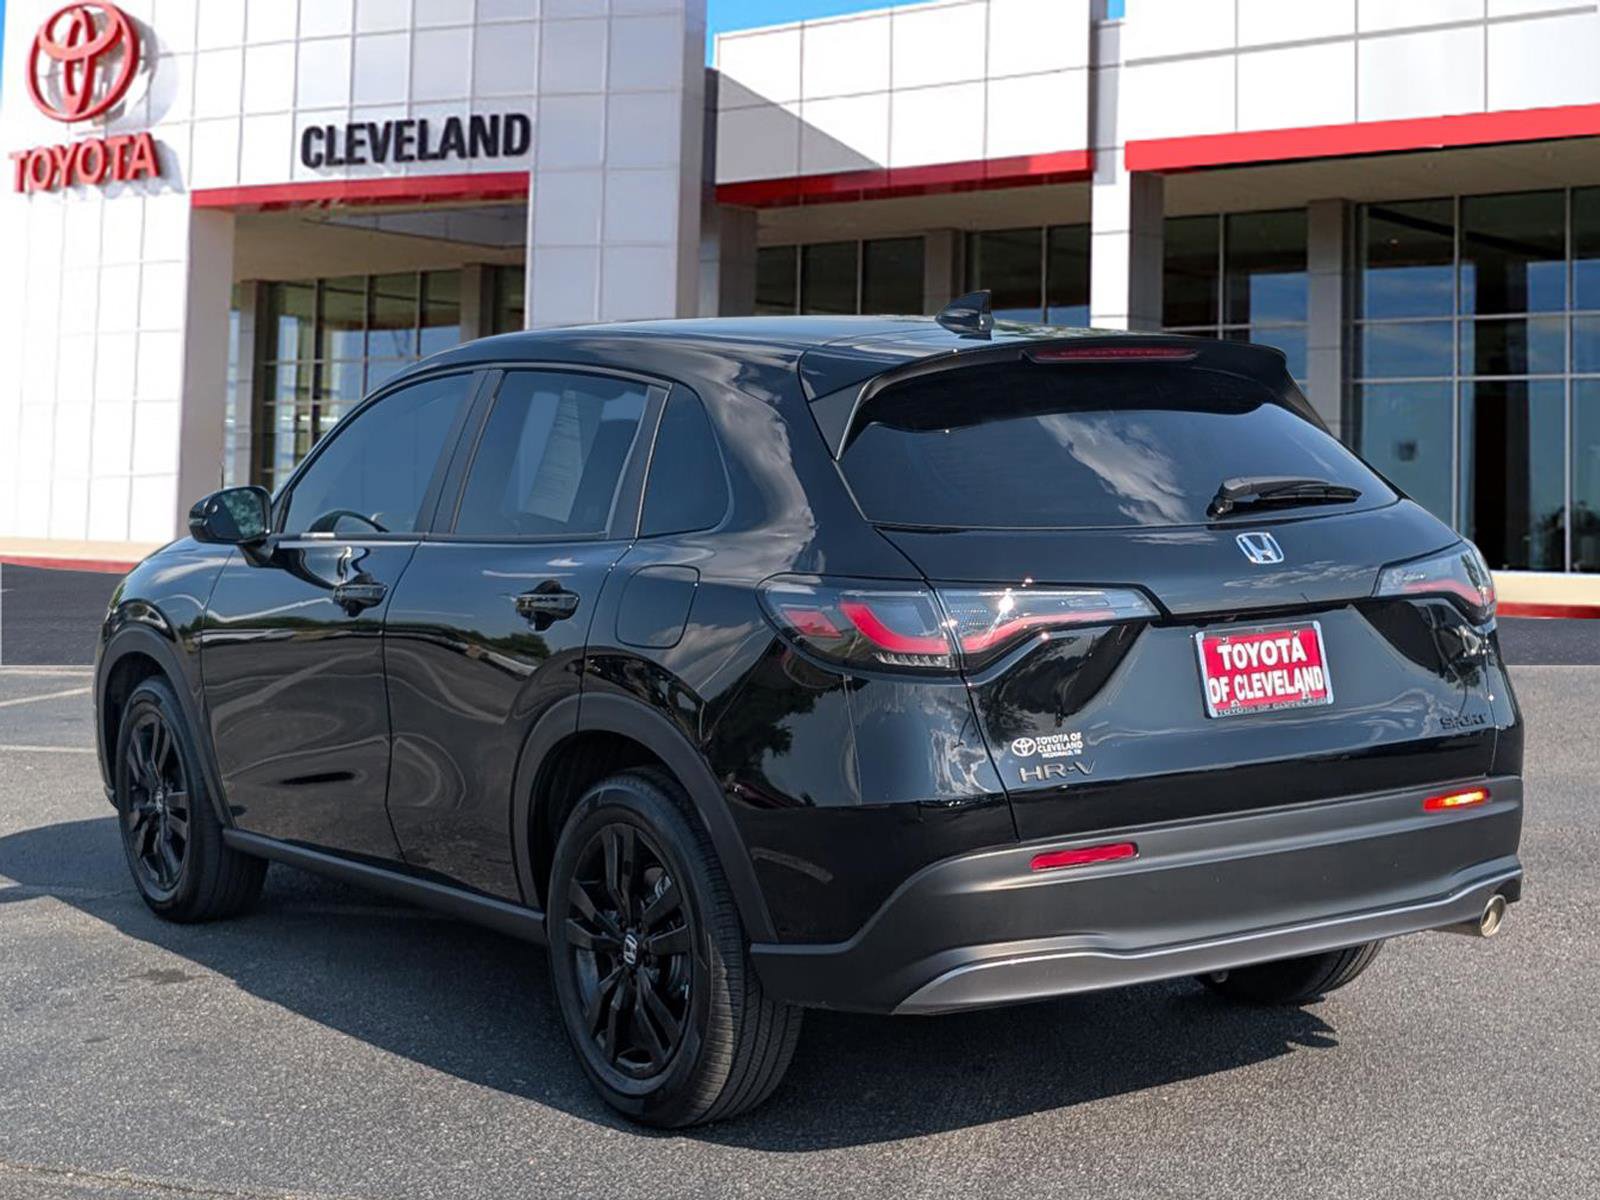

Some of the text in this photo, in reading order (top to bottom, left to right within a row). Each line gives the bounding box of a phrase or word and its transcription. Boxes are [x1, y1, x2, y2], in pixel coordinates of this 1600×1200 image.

[301, 112, 531, 168] CLEVELAND
[9, 132, 162, 193] TOYOTA
[1216, 637, 1307, 670] TOYOTA
[1208, 667, 1324, 704] OF CLEVELAND
[1036, 732, 1081, 745] TOYOTA OF
[1037, 741, 1083, 752] CLEVELAND
[1020, 760, 1095, 782] HR-V
